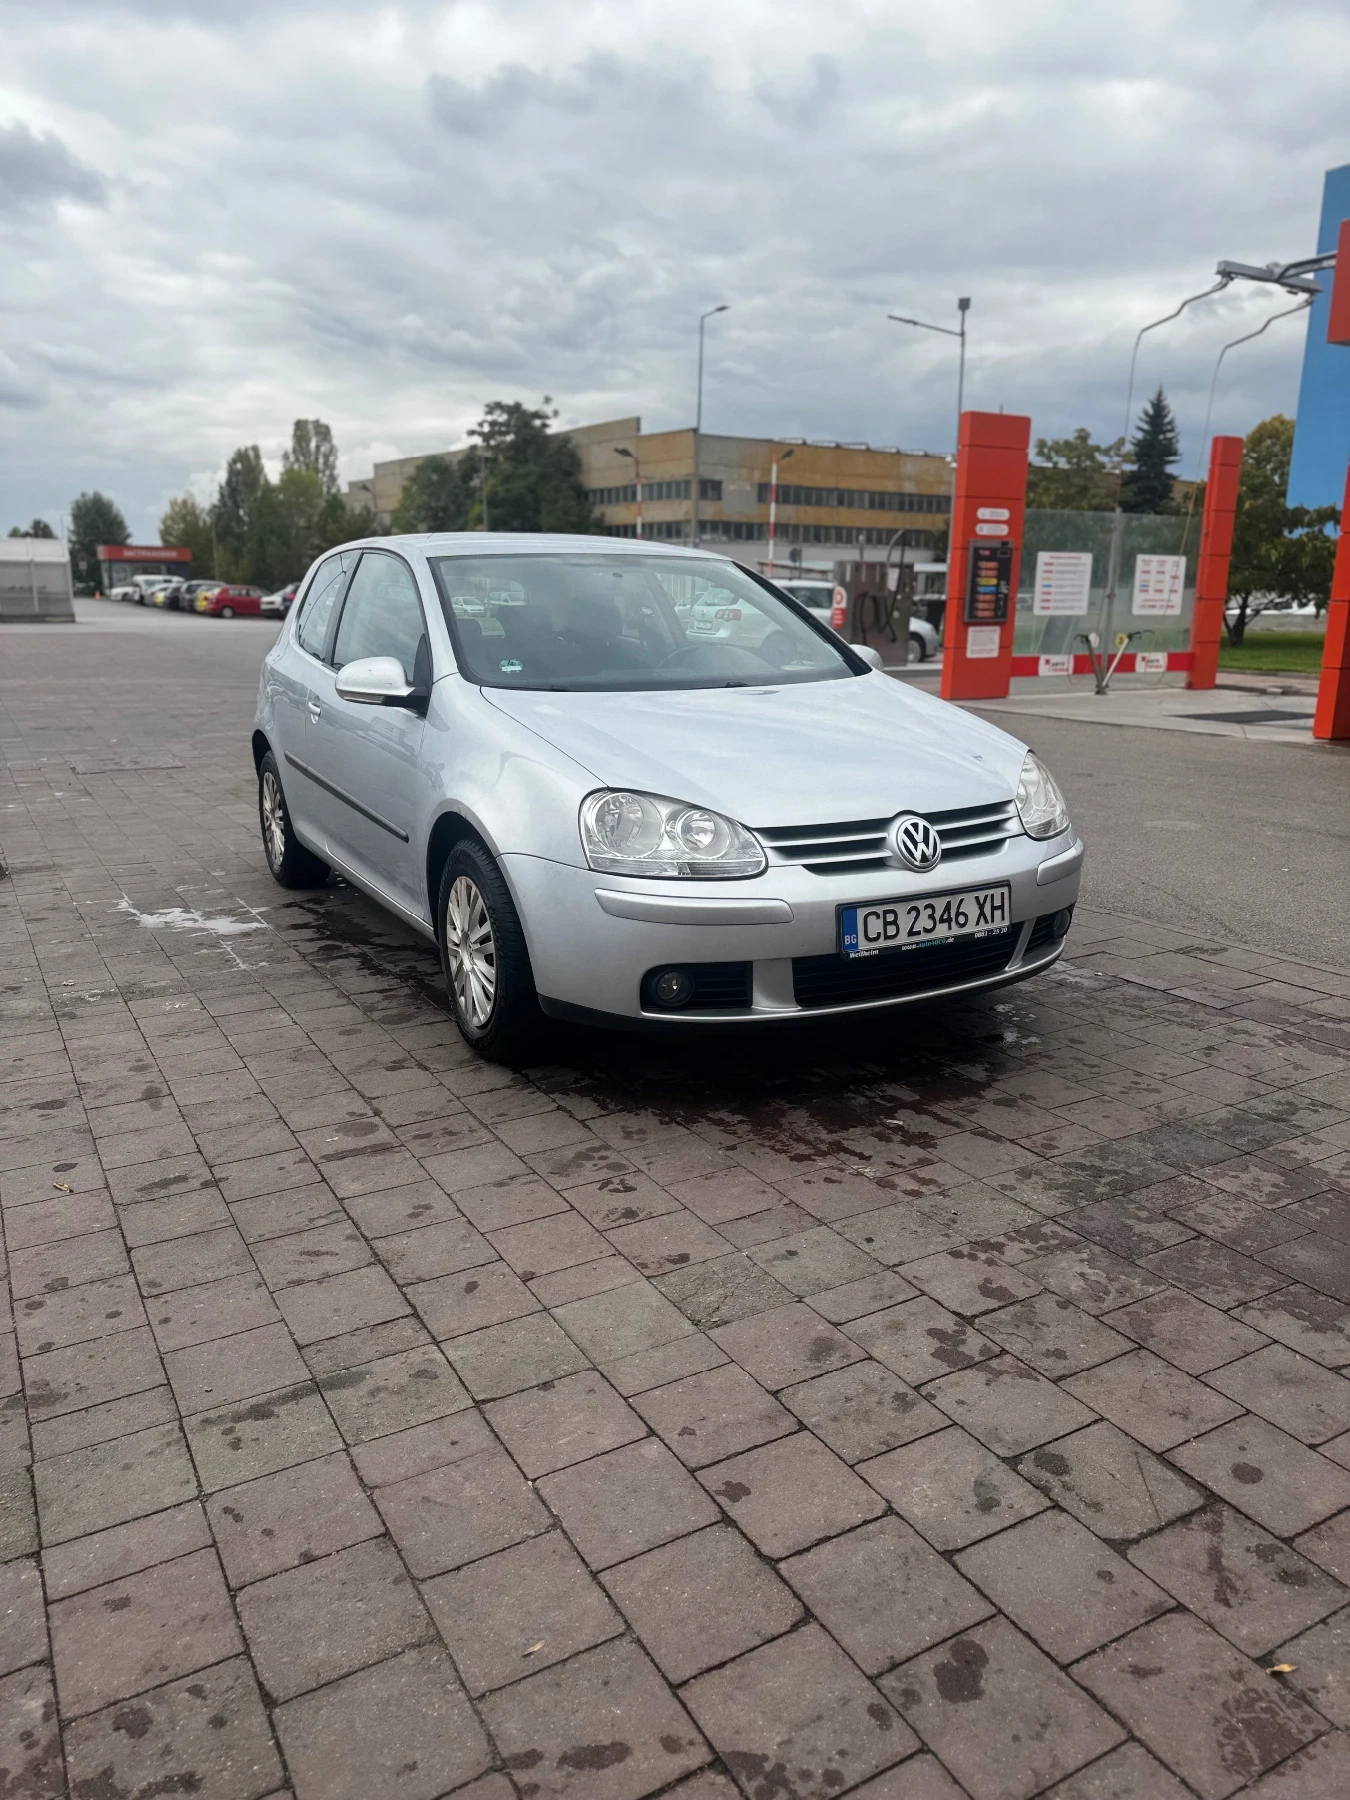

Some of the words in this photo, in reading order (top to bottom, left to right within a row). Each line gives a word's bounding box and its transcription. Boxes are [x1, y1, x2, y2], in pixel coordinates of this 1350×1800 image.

[863, 908, 900, 942] CB
[906, 899, 969, 938] 2346
[974, 891, 1006, 926] XH
[844, 934, 857, 946] BG
